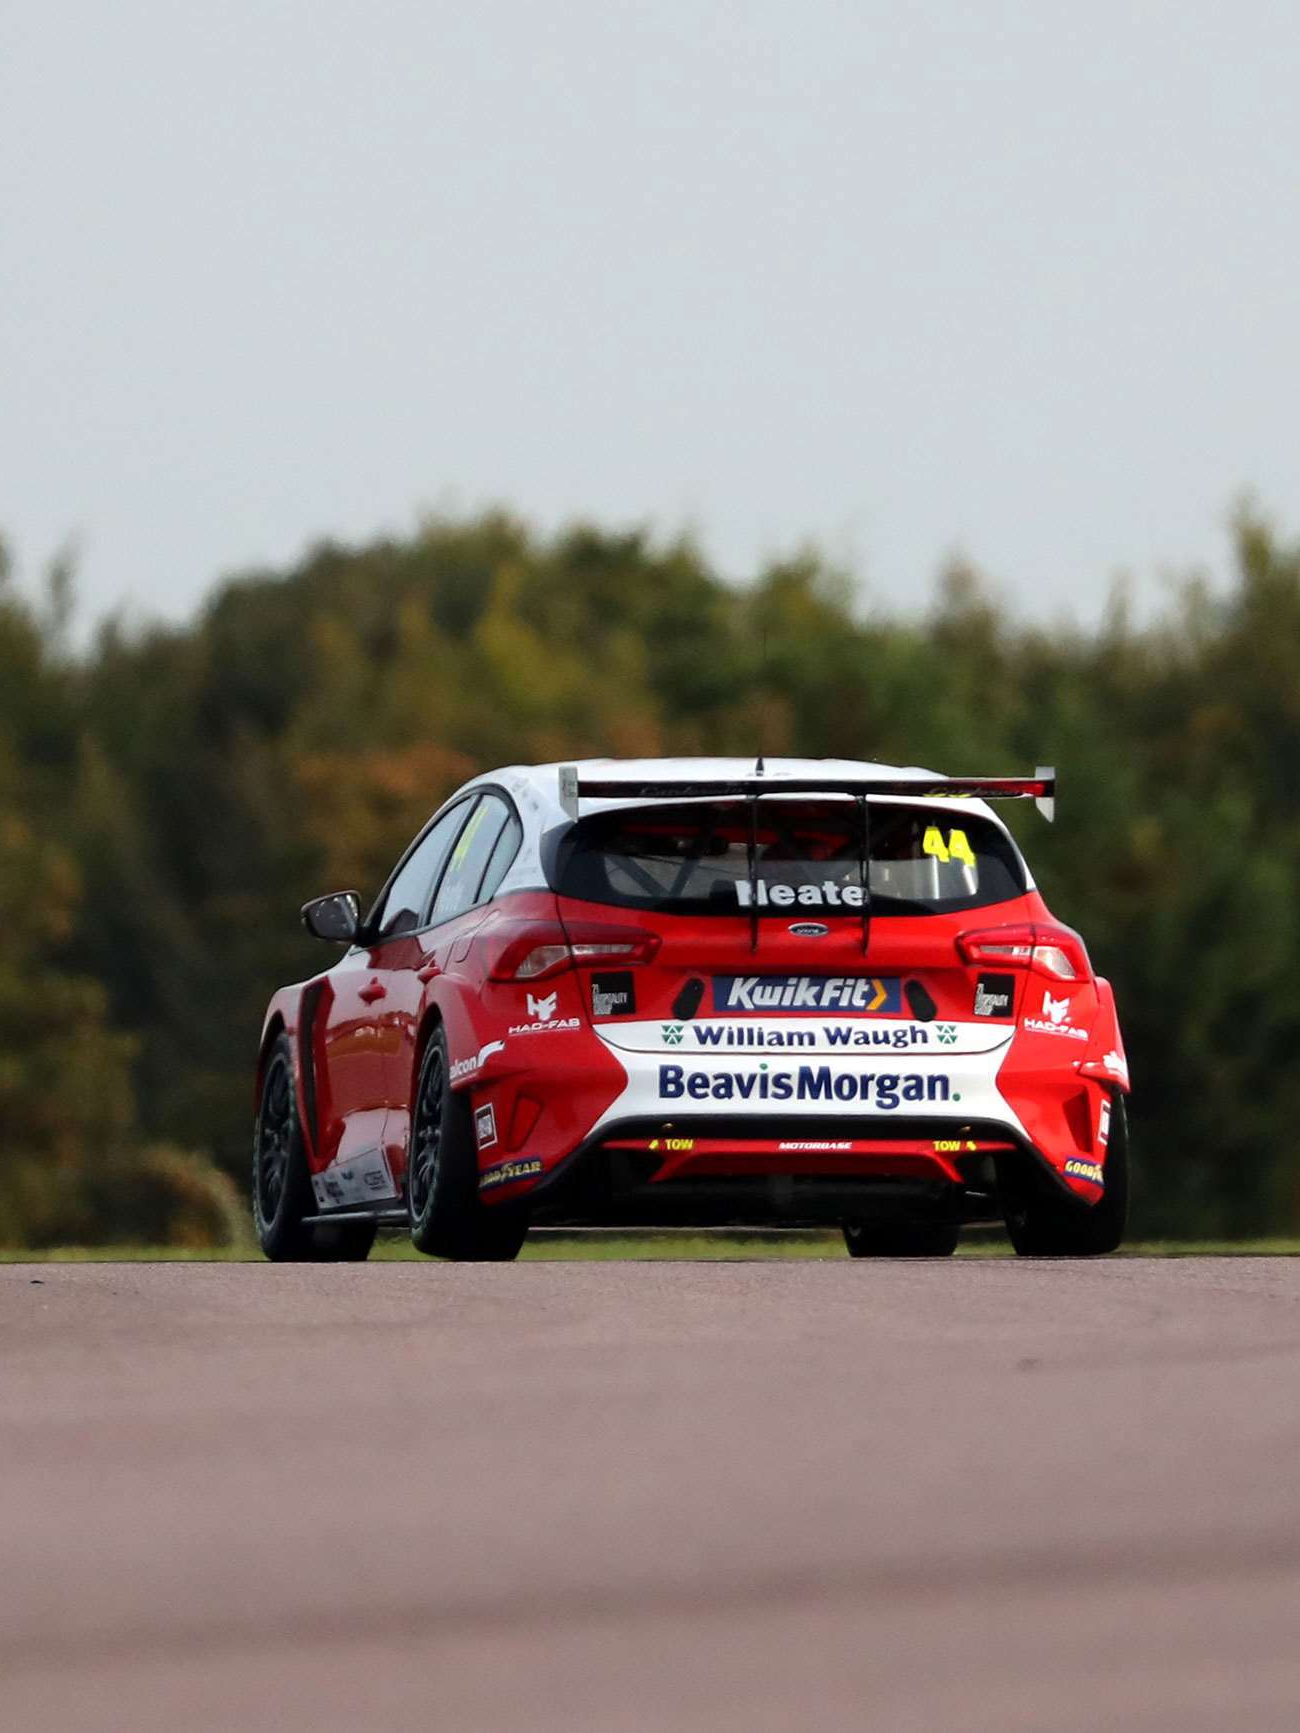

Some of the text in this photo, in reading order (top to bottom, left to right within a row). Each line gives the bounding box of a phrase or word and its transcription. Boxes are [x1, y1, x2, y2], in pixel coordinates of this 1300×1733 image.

[922, 826, 976, 867] 44
[734, 879, 868, 907] Neate
[508, 1017, 581, 1034] HAD-FAB
[693, 1024, 929, 1048] William Waugh
[665, 1138, 693, 1150] TOW
[779, 1141, 853, 1150] MOTORBASE
[933, 1140, 960, 1151] TOW
